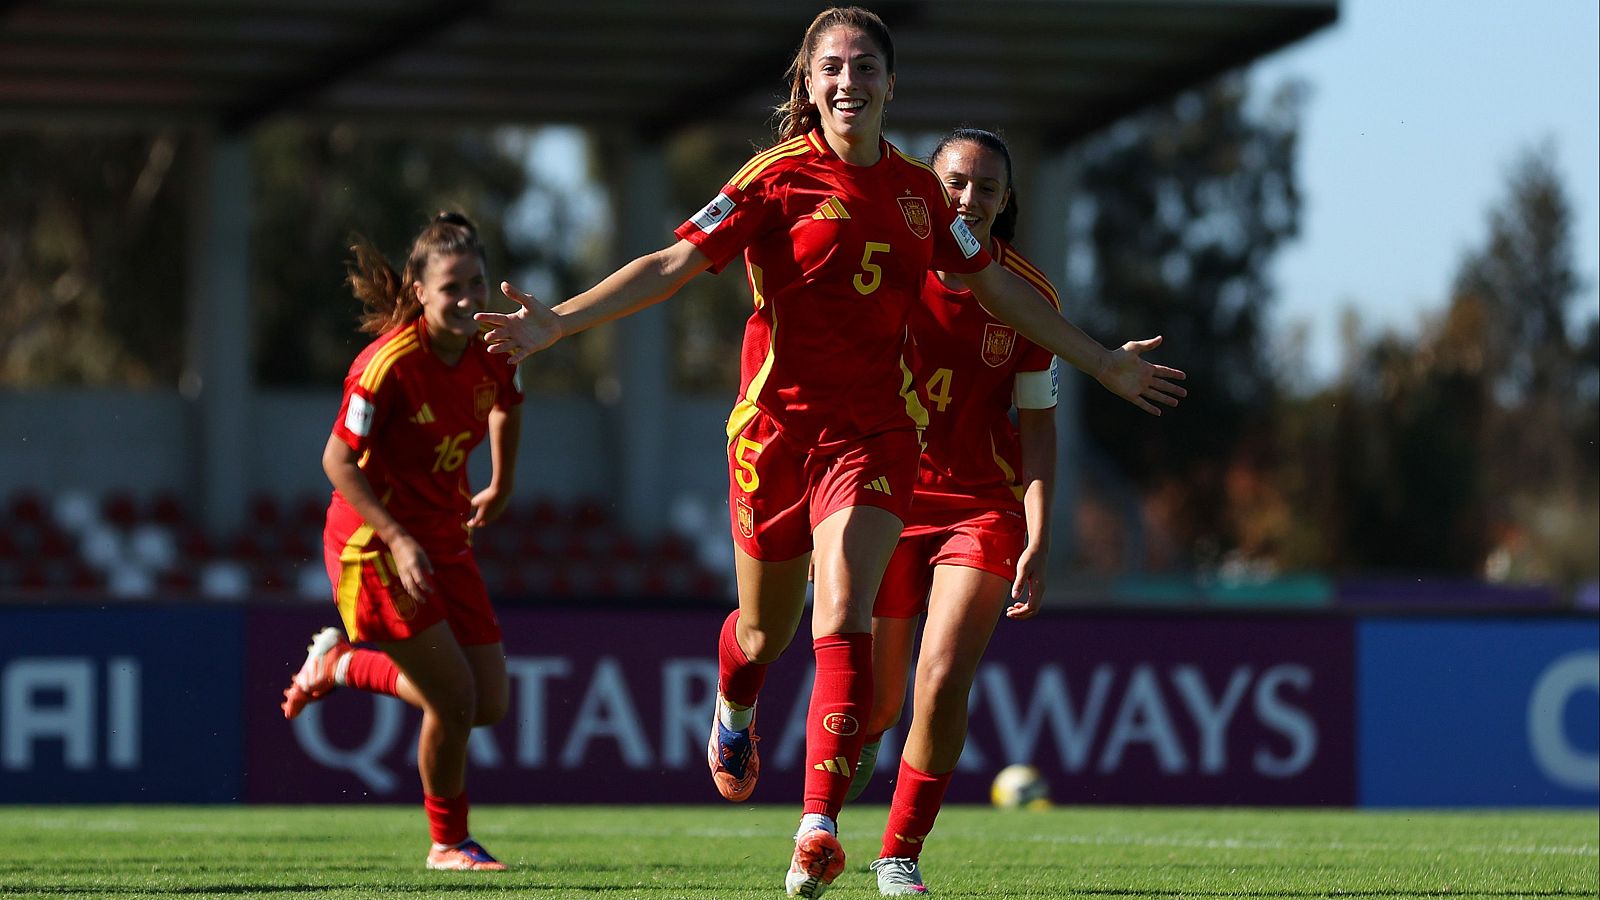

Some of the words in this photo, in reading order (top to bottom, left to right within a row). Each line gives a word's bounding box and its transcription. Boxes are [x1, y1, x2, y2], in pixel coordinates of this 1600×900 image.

[853, 242, 890, 295] 5
[926, 368, 953, 412] 4
[432, 430, 471, 473] 16
[735, 435, 762, 492] 5
[291, 655, 720, 794] QTAR
[772, 658, 1318, 776] WAYS
